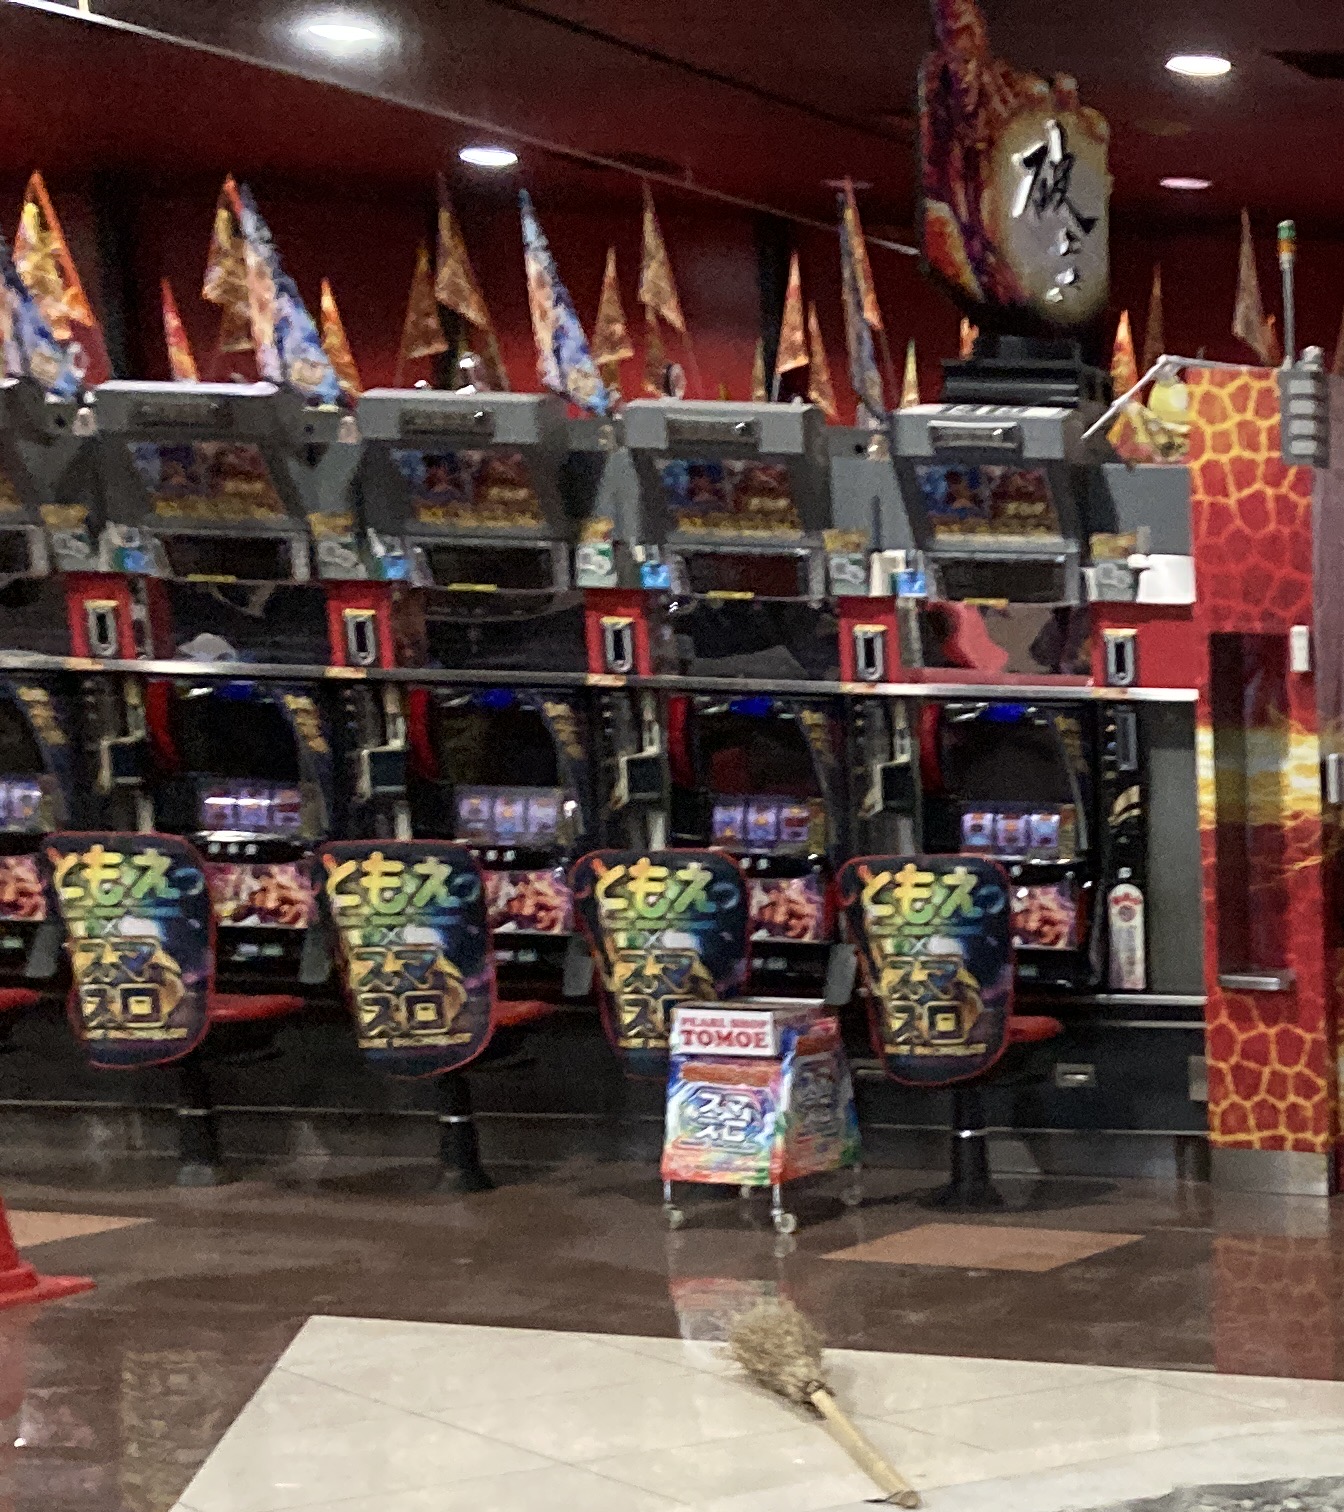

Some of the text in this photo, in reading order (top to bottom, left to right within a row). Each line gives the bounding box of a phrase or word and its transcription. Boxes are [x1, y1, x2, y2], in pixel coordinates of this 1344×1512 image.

[46, 844, 181, 906] ともえ
[322, 851, 461, 914] ともえ
[592, 857, 716, 918] ともえ
[857, 863, 983, 924] ともえ
[681, 1030, 769, 1048] TOMOE
